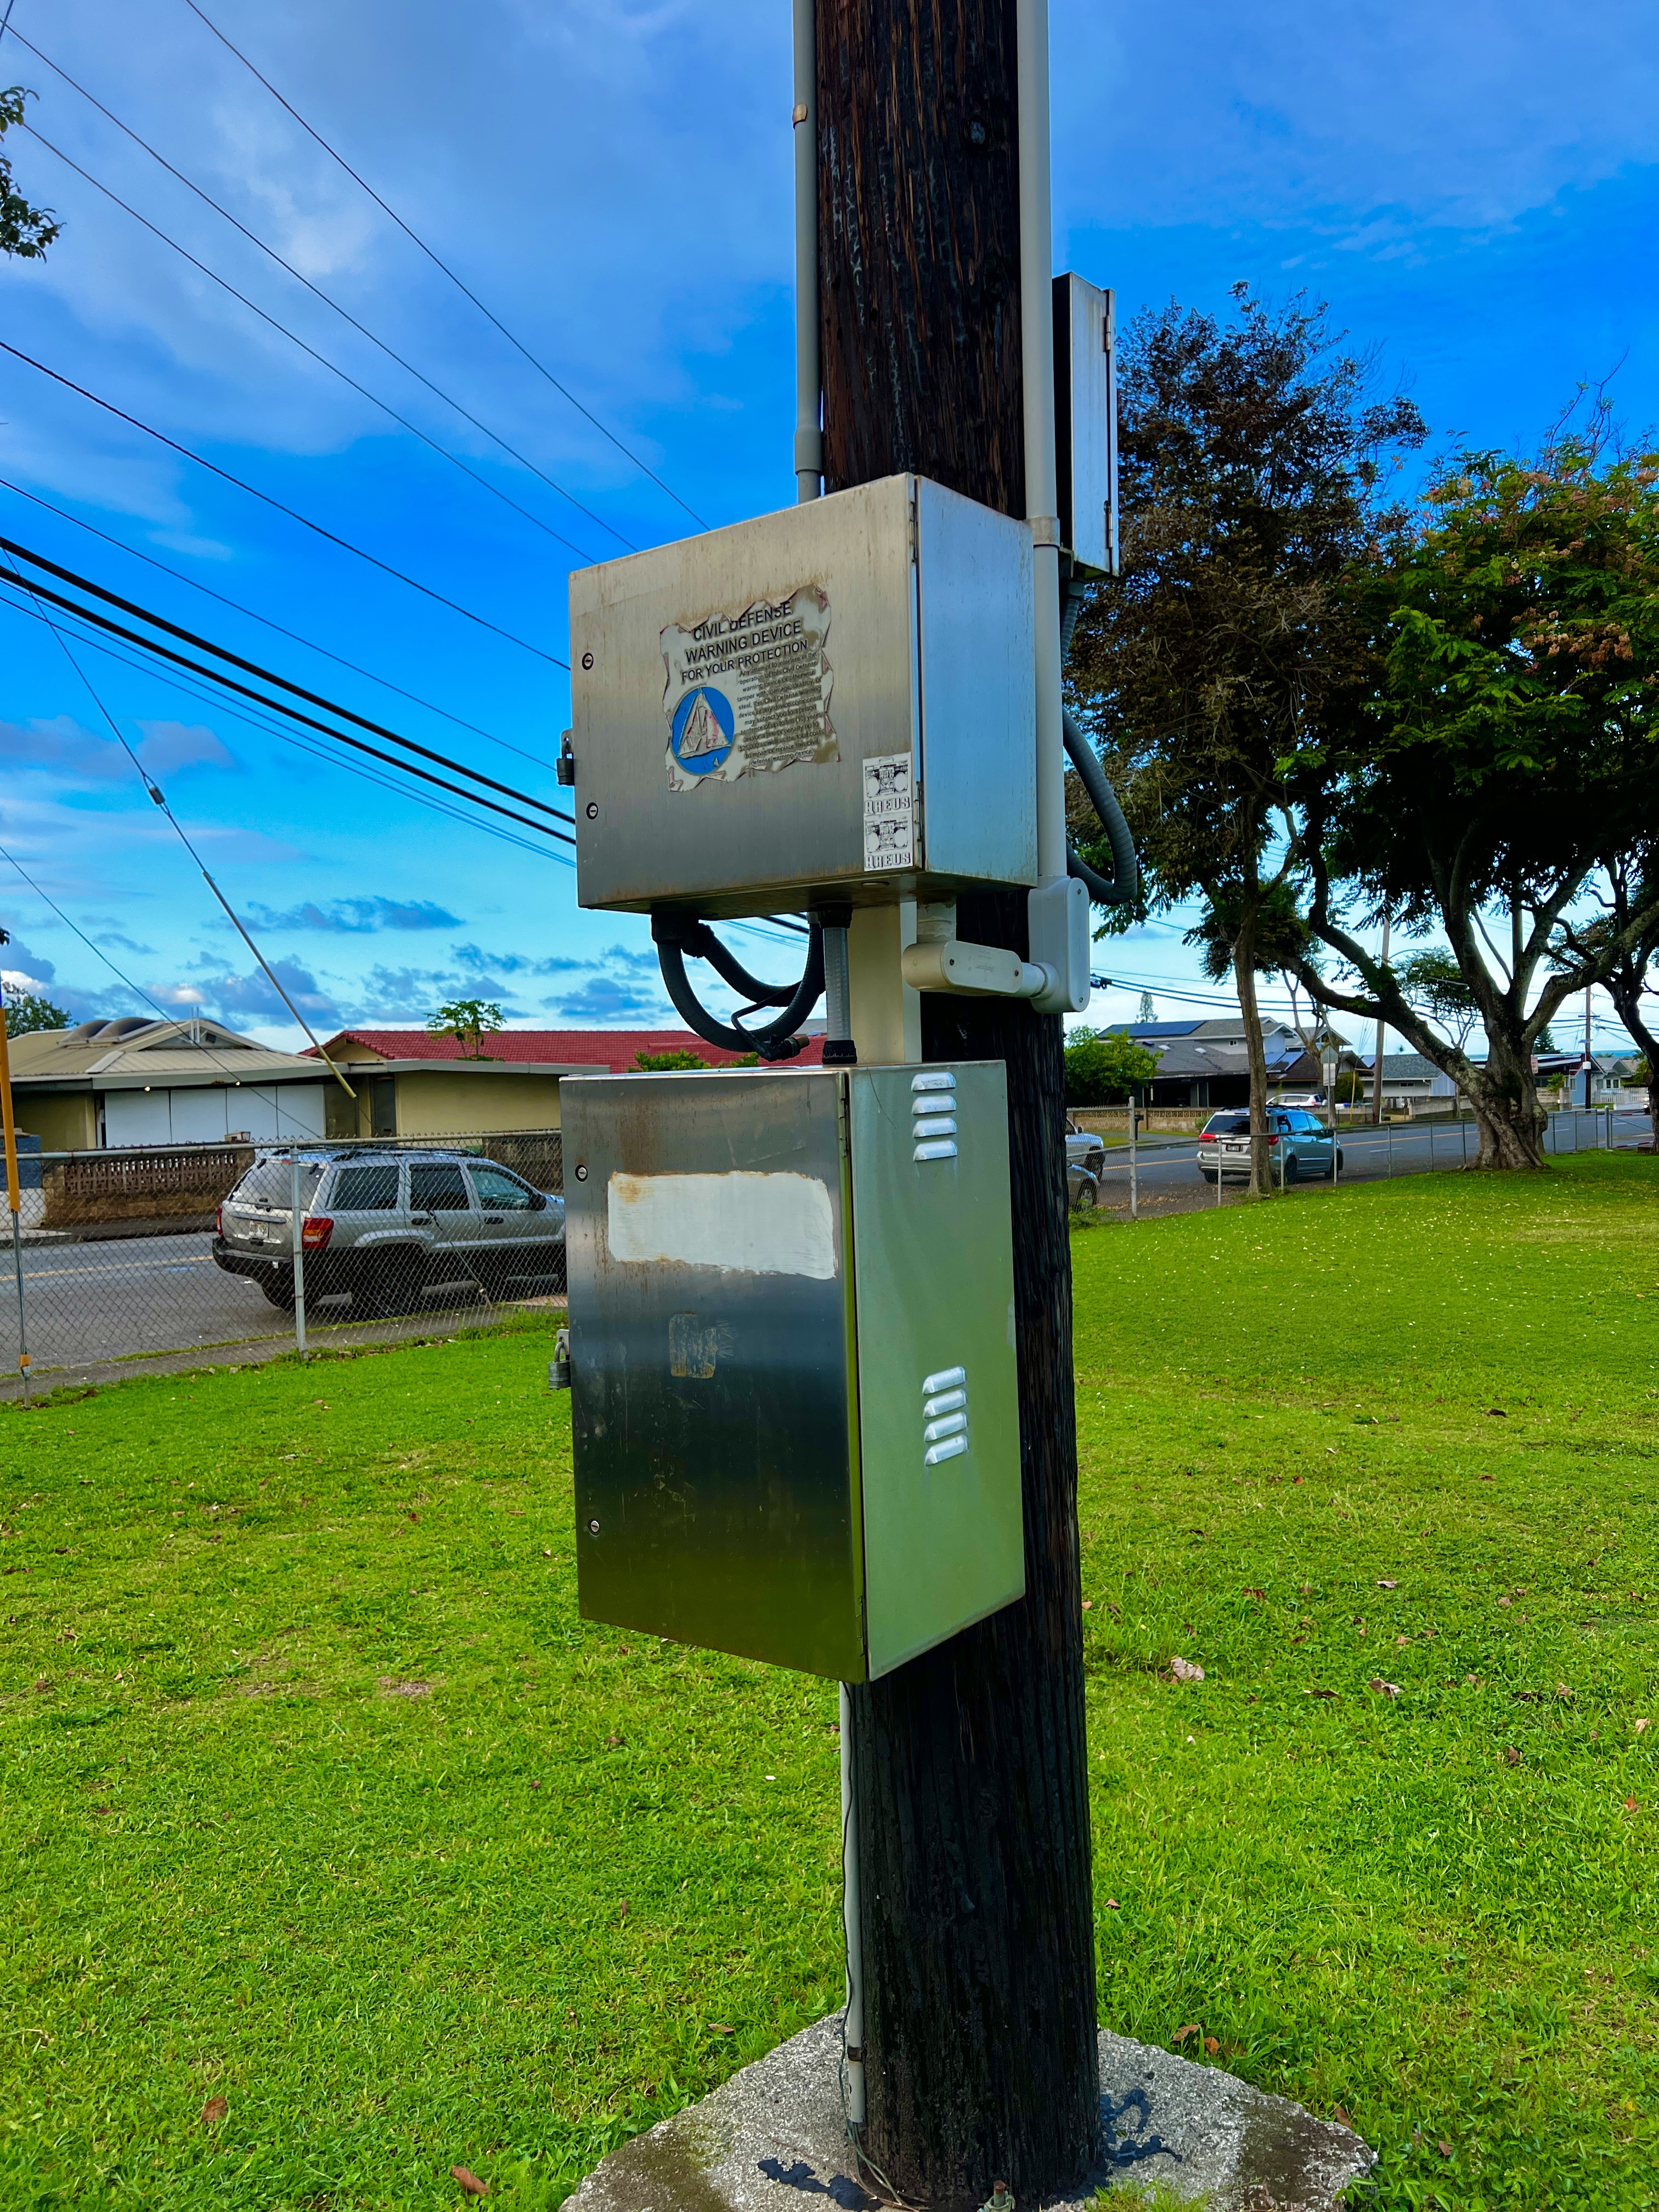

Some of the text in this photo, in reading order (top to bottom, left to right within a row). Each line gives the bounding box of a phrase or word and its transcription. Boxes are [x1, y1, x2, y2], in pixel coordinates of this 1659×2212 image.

[693, 601, 792, 641] CIVIL DEFENSE
[686, 620, 802, 662] WARNING DEVICE
[682, 639, 808, 682] FOR YOUR PROTECTION
[751, 664, 770, 673] attempt
[778, 657, 800, 665] interfere
[740, 675, 764, 685] operation
[796, 661, 817, 670] Defense
[743, 683, 763, 692] warning
[789, 670, 815, 680] otherwise
[737, 693, 754, 702] tamper
[792, 695, 822, 706] component
[799, 704, 816, 714] prison
[741, 726, 763, 735] sentence
[785, 725, 803, 735] penalty
[772, 752, 794, 761] warning
